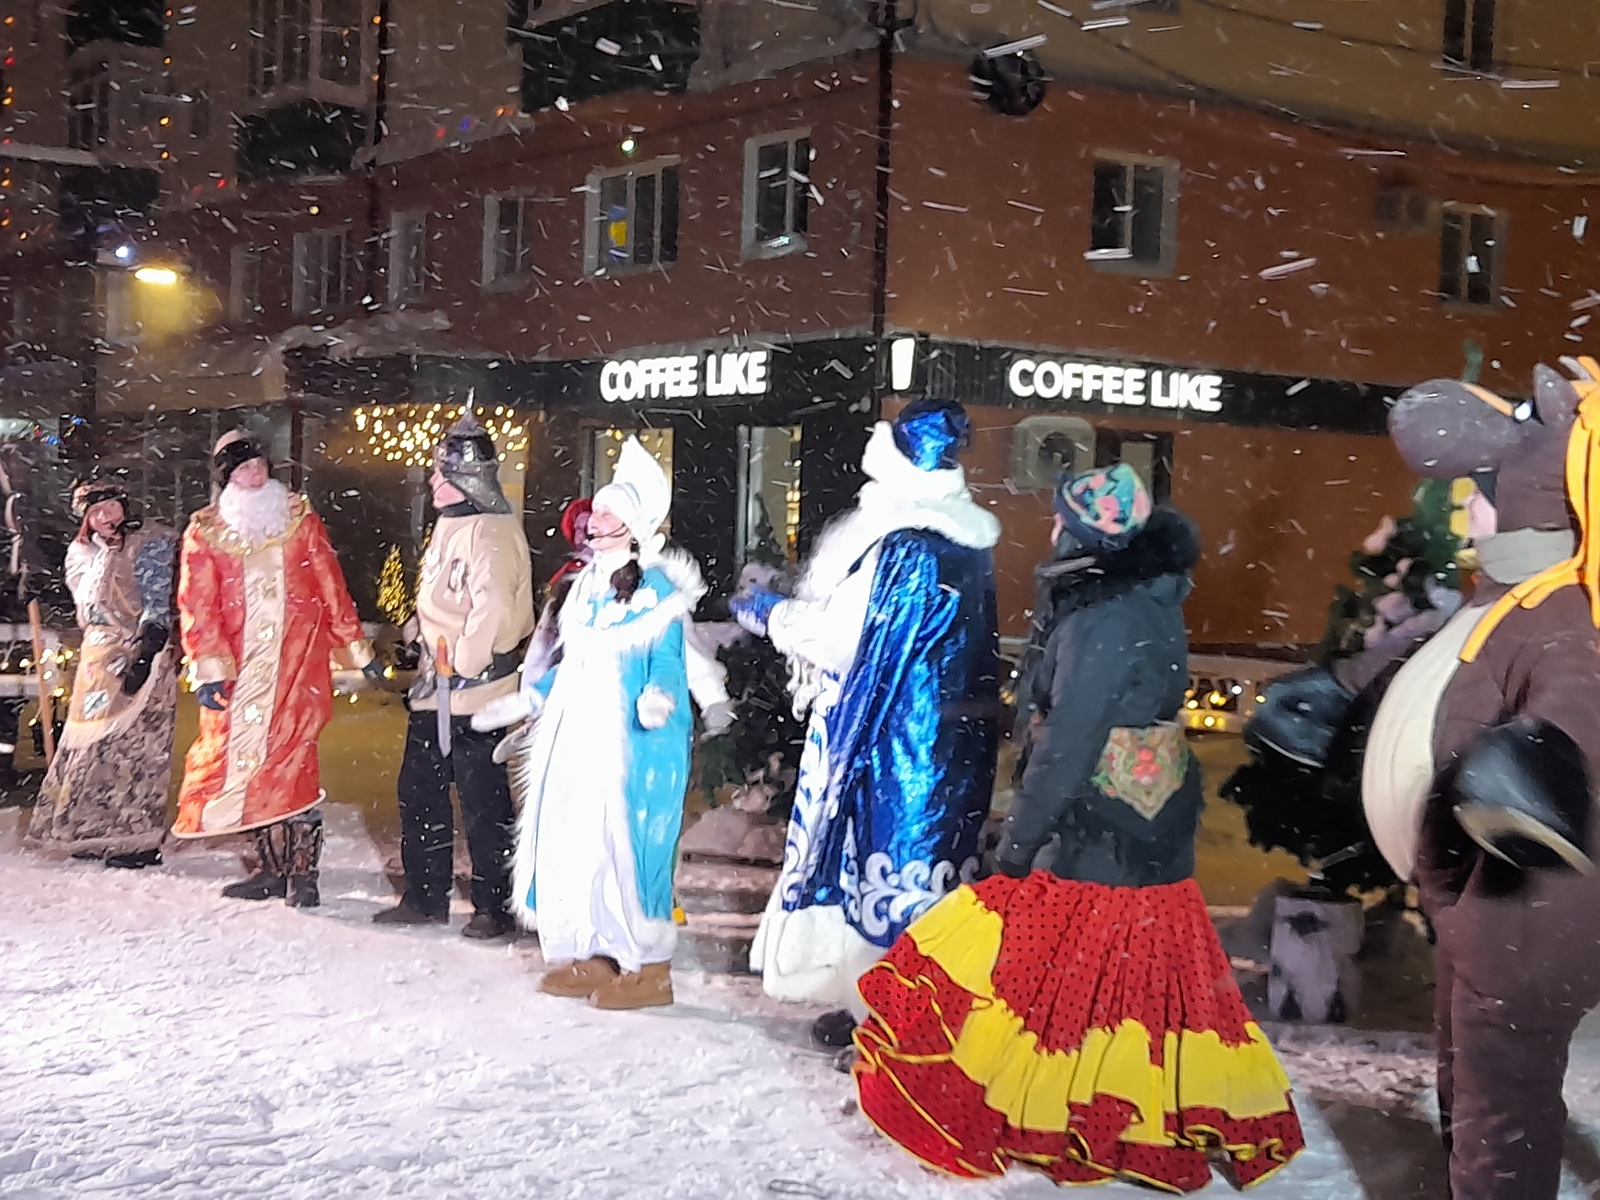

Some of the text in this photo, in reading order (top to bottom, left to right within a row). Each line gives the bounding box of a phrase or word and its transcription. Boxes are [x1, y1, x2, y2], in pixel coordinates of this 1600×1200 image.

[600, 350, 767, 402] COFFEE LIKE
[1009, 359, 1222, 412] COFFEE LIKE
